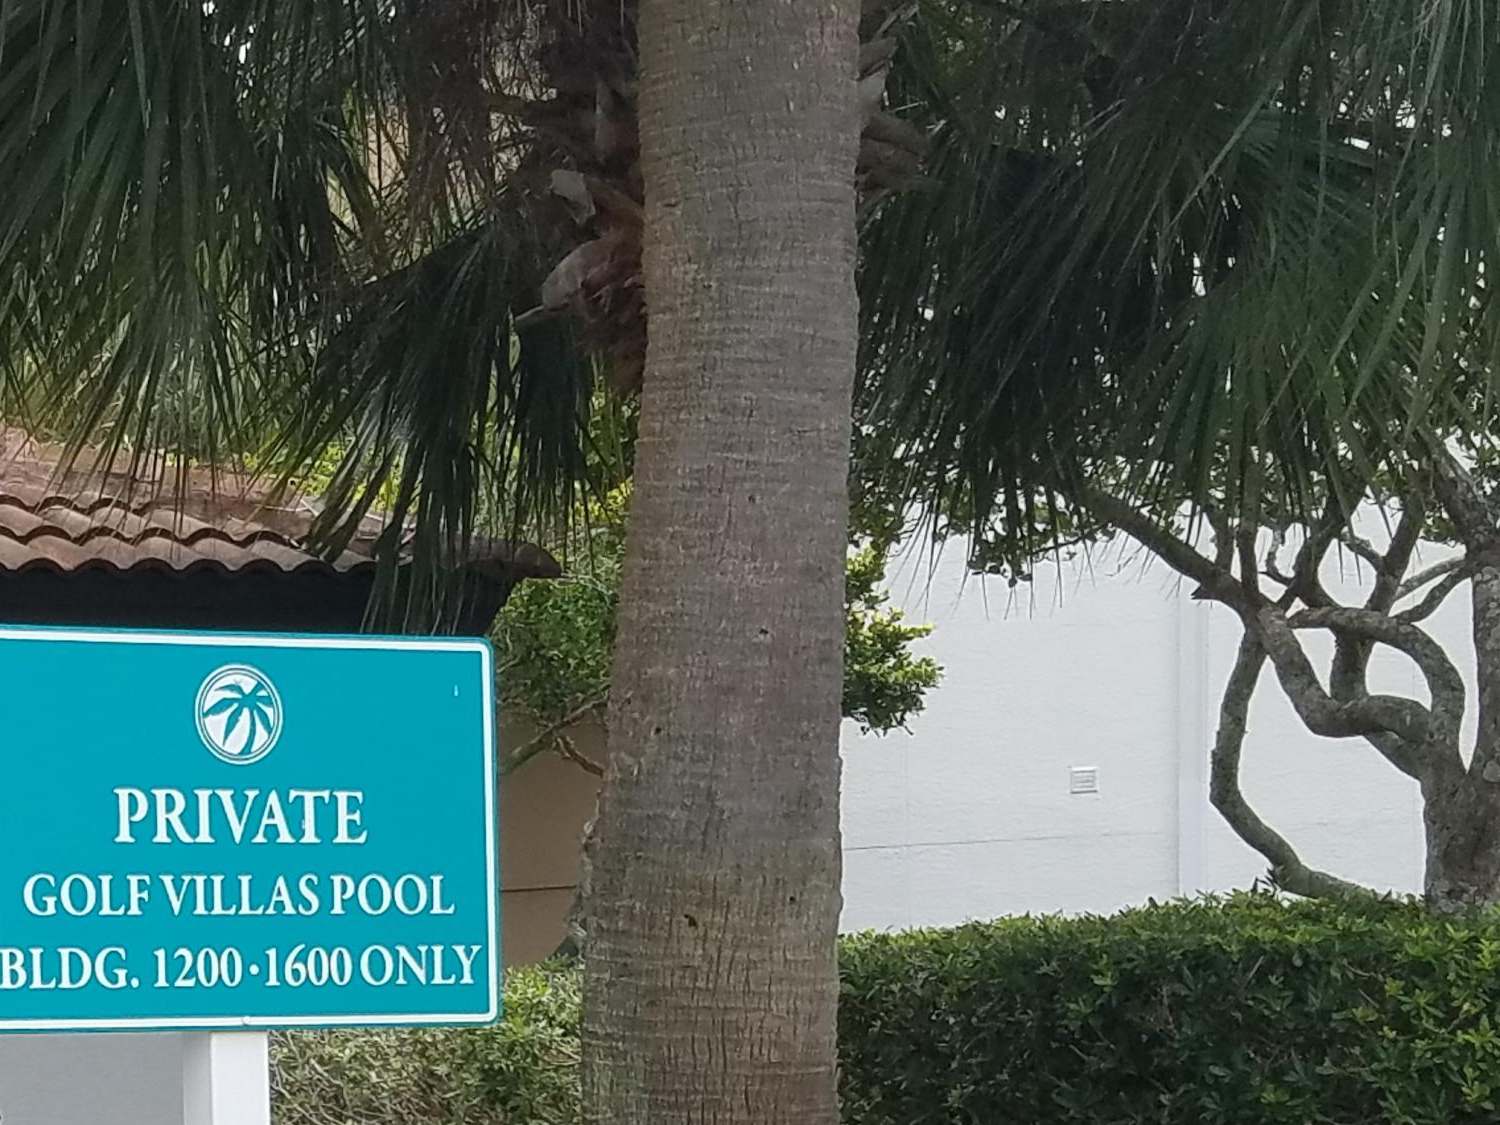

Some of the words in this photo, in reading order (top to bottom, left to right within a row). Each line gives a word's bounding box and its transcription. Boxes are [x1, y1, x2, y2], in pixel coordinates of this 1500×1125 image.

[113, 787, 367, 844] PRIVATE
[23, 873, 150, 916] GOLF
[160, 873, 320, 916] VILLAS
[330, 873, 455, 915] POOL
[360, 944, 482, 986] ONLY
